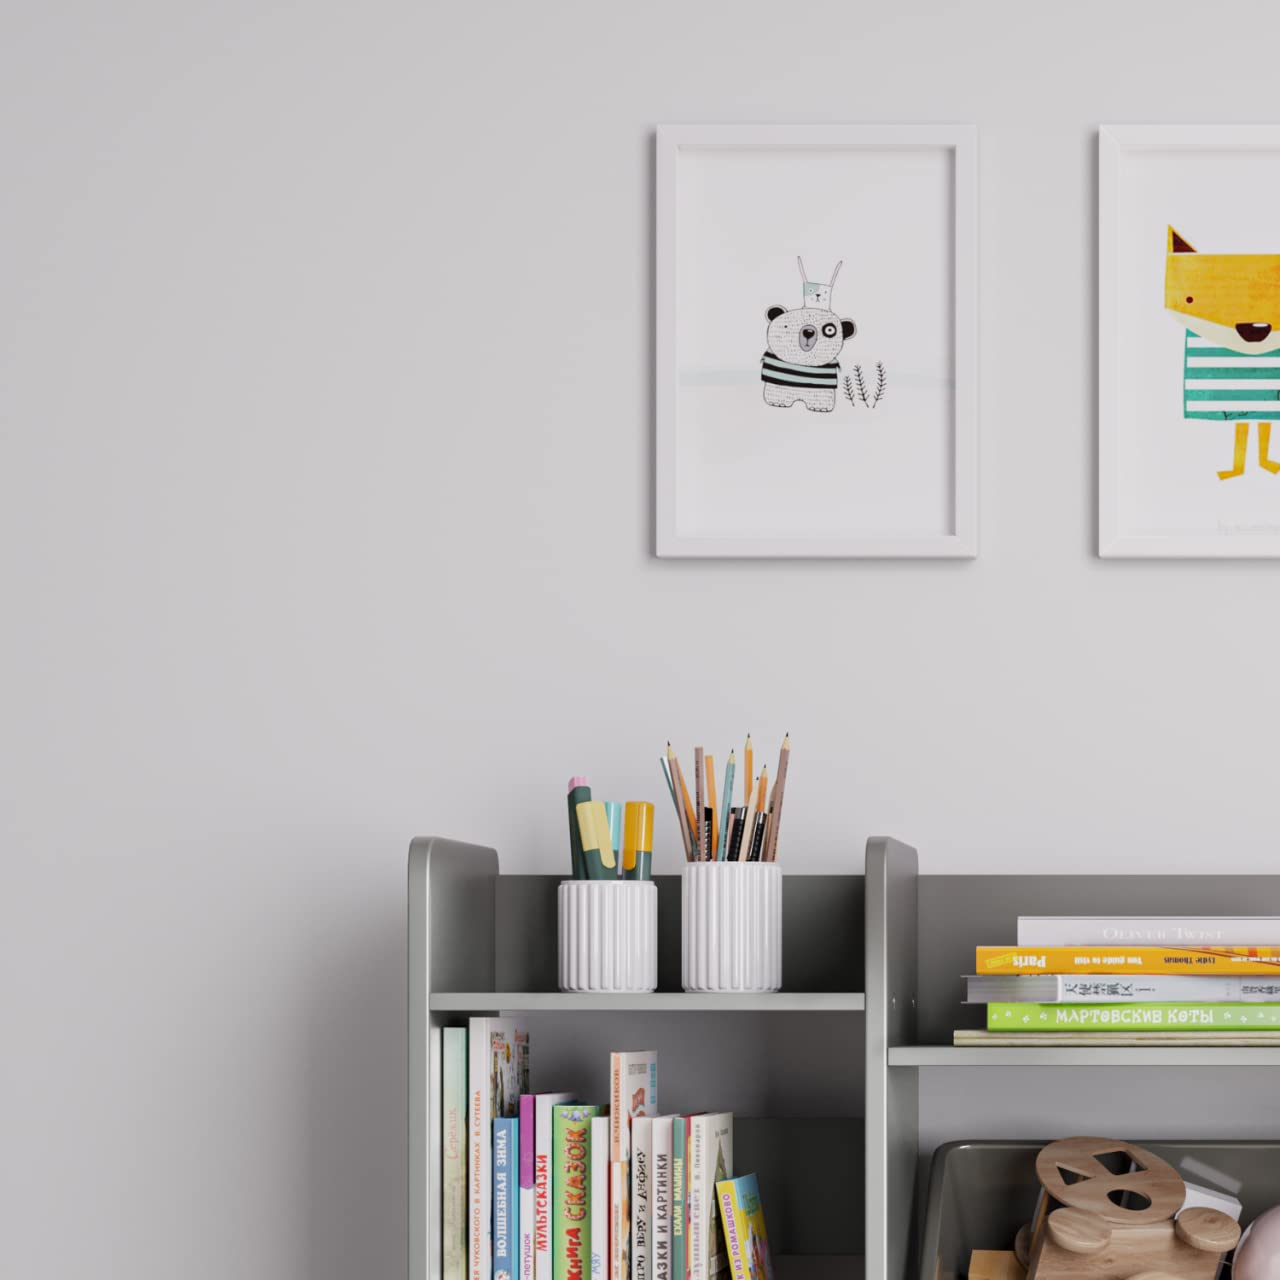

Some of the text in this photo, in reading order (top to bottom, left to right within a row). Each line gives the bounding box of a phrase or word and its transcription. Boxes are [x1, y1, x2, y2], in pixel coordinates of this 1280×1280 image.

[1012, 954, 1047, 968] Paris
[1167, 1008, 1214, 1025] КОТЫ
[473, 1089, 481, 1126] СУТЕЕВА
[473, 1142, 481, 1195] КАРТИНКАХ
[496, 1129, 507, 1167] ЗИМА
[563, 1127, 588, 1222] СКАЗОК
[656, 1153, 669, 1222] КАРТИНКИ
[496, 1172, 507, 1257] ВОЛШЕБНАЯ
[656, 1224, 669, 1234] И
[722, 1193, 740, 1256] РОМАШКОВО
[473, 1207, 481, 1268] ЧУКОВСКОГО
[733, 1257, 744, 1272] ИЗ
